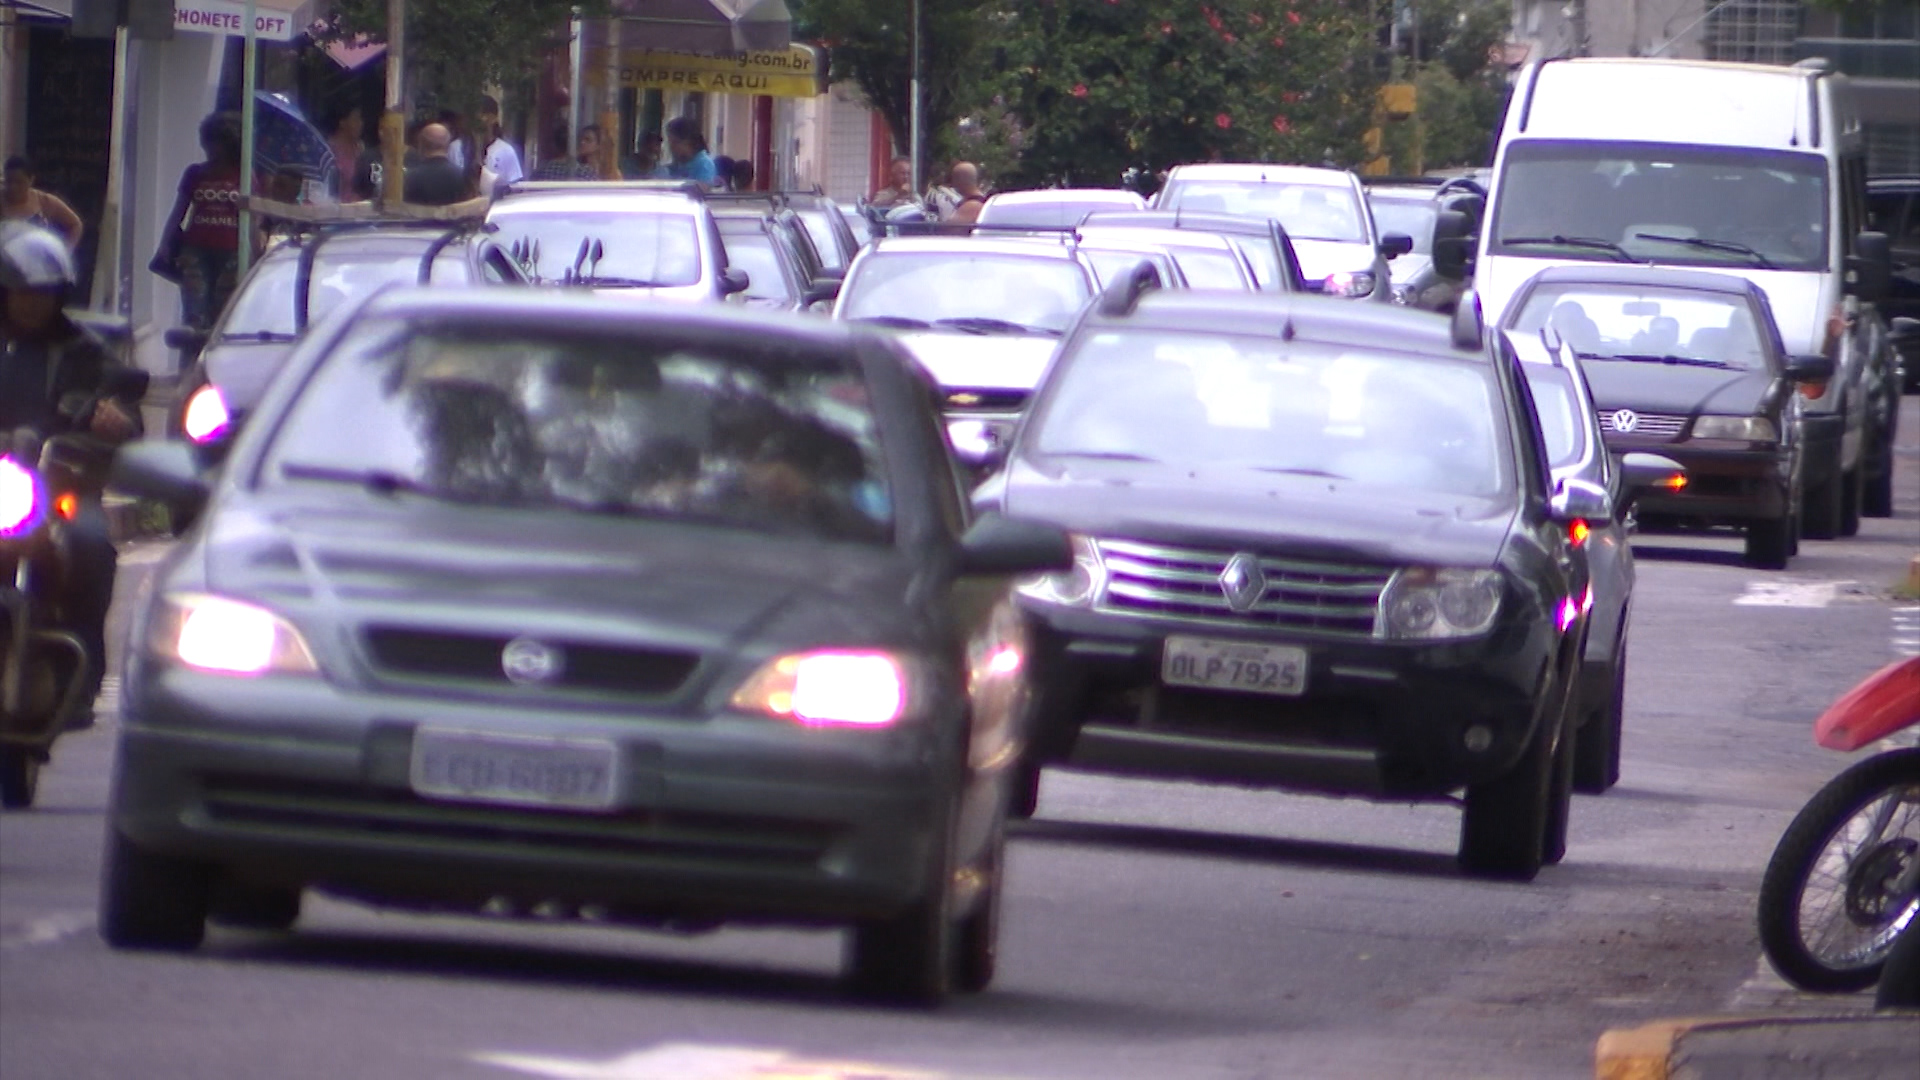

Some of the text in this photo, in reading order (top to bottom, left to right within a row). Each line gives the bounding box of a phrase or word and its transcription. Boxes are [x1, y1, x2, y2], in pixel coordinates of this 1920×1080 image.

[174, 9, 286, 33] HONETE OFT
[619, 68, 769, 88] OMPRE AQUI
[193, 189, 240, 202] COCO
